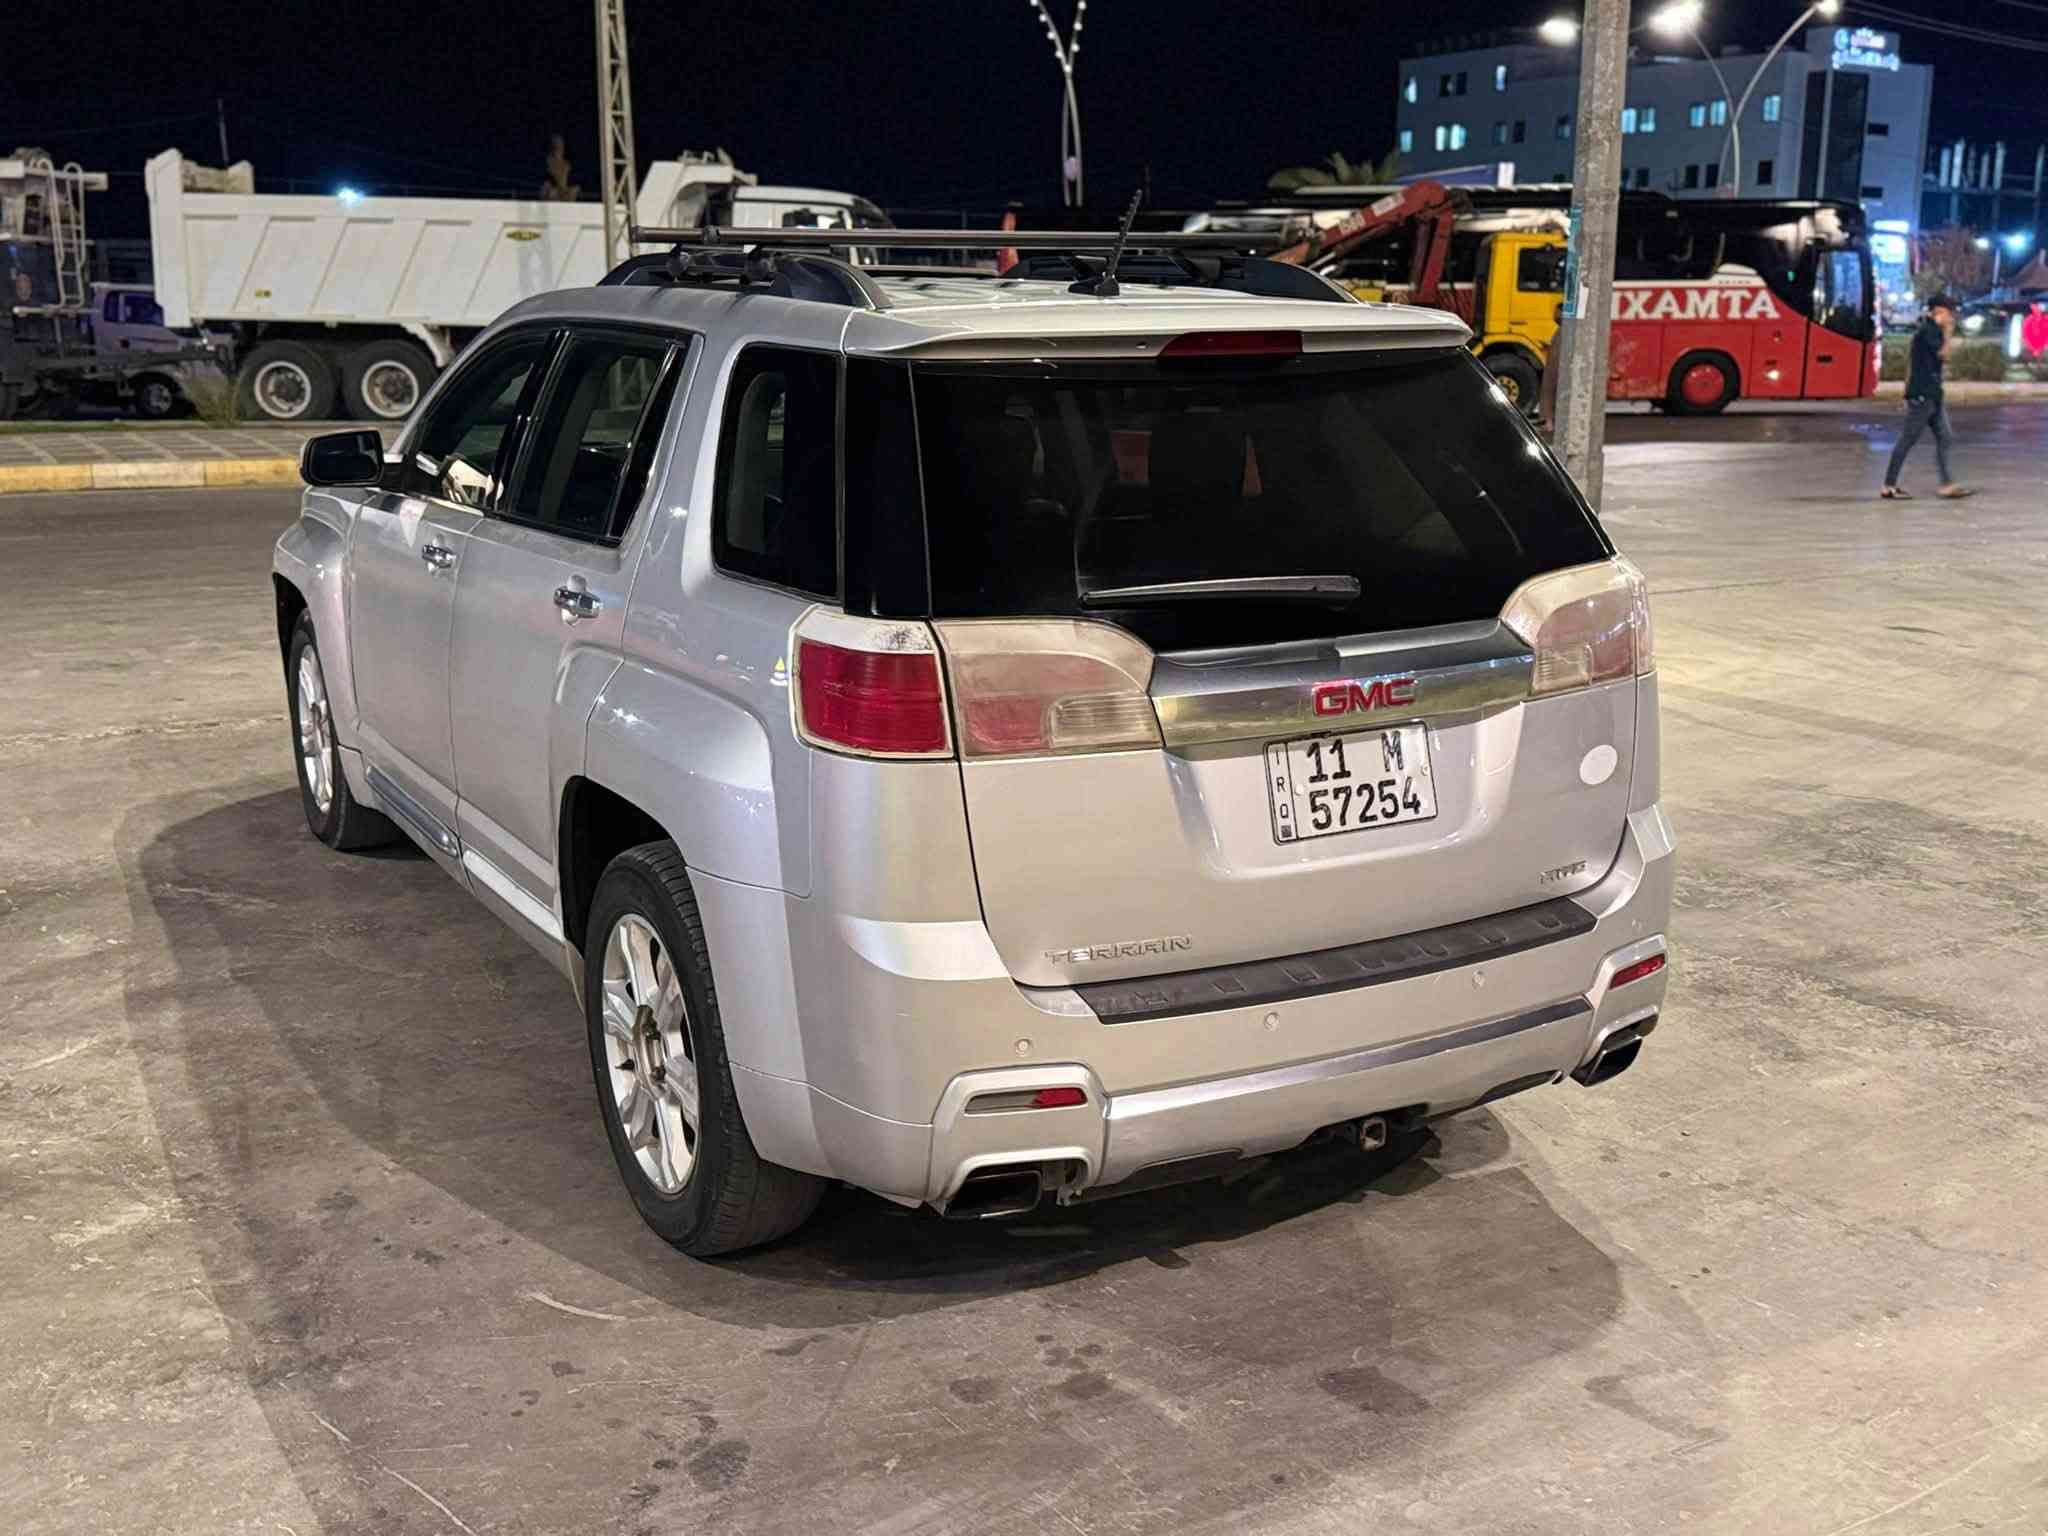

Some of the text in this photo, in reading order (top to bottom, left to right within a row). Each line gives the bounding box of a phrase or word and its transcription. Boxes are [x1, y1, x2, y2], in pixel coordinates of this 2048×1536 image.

[1312, 675, 1418, 717] GMC
[1306, 731, 1404, 783] 11 M
[1309, 776, 1421, 830] 57254
[1044, 935, 1193, 966] TERRAIN
